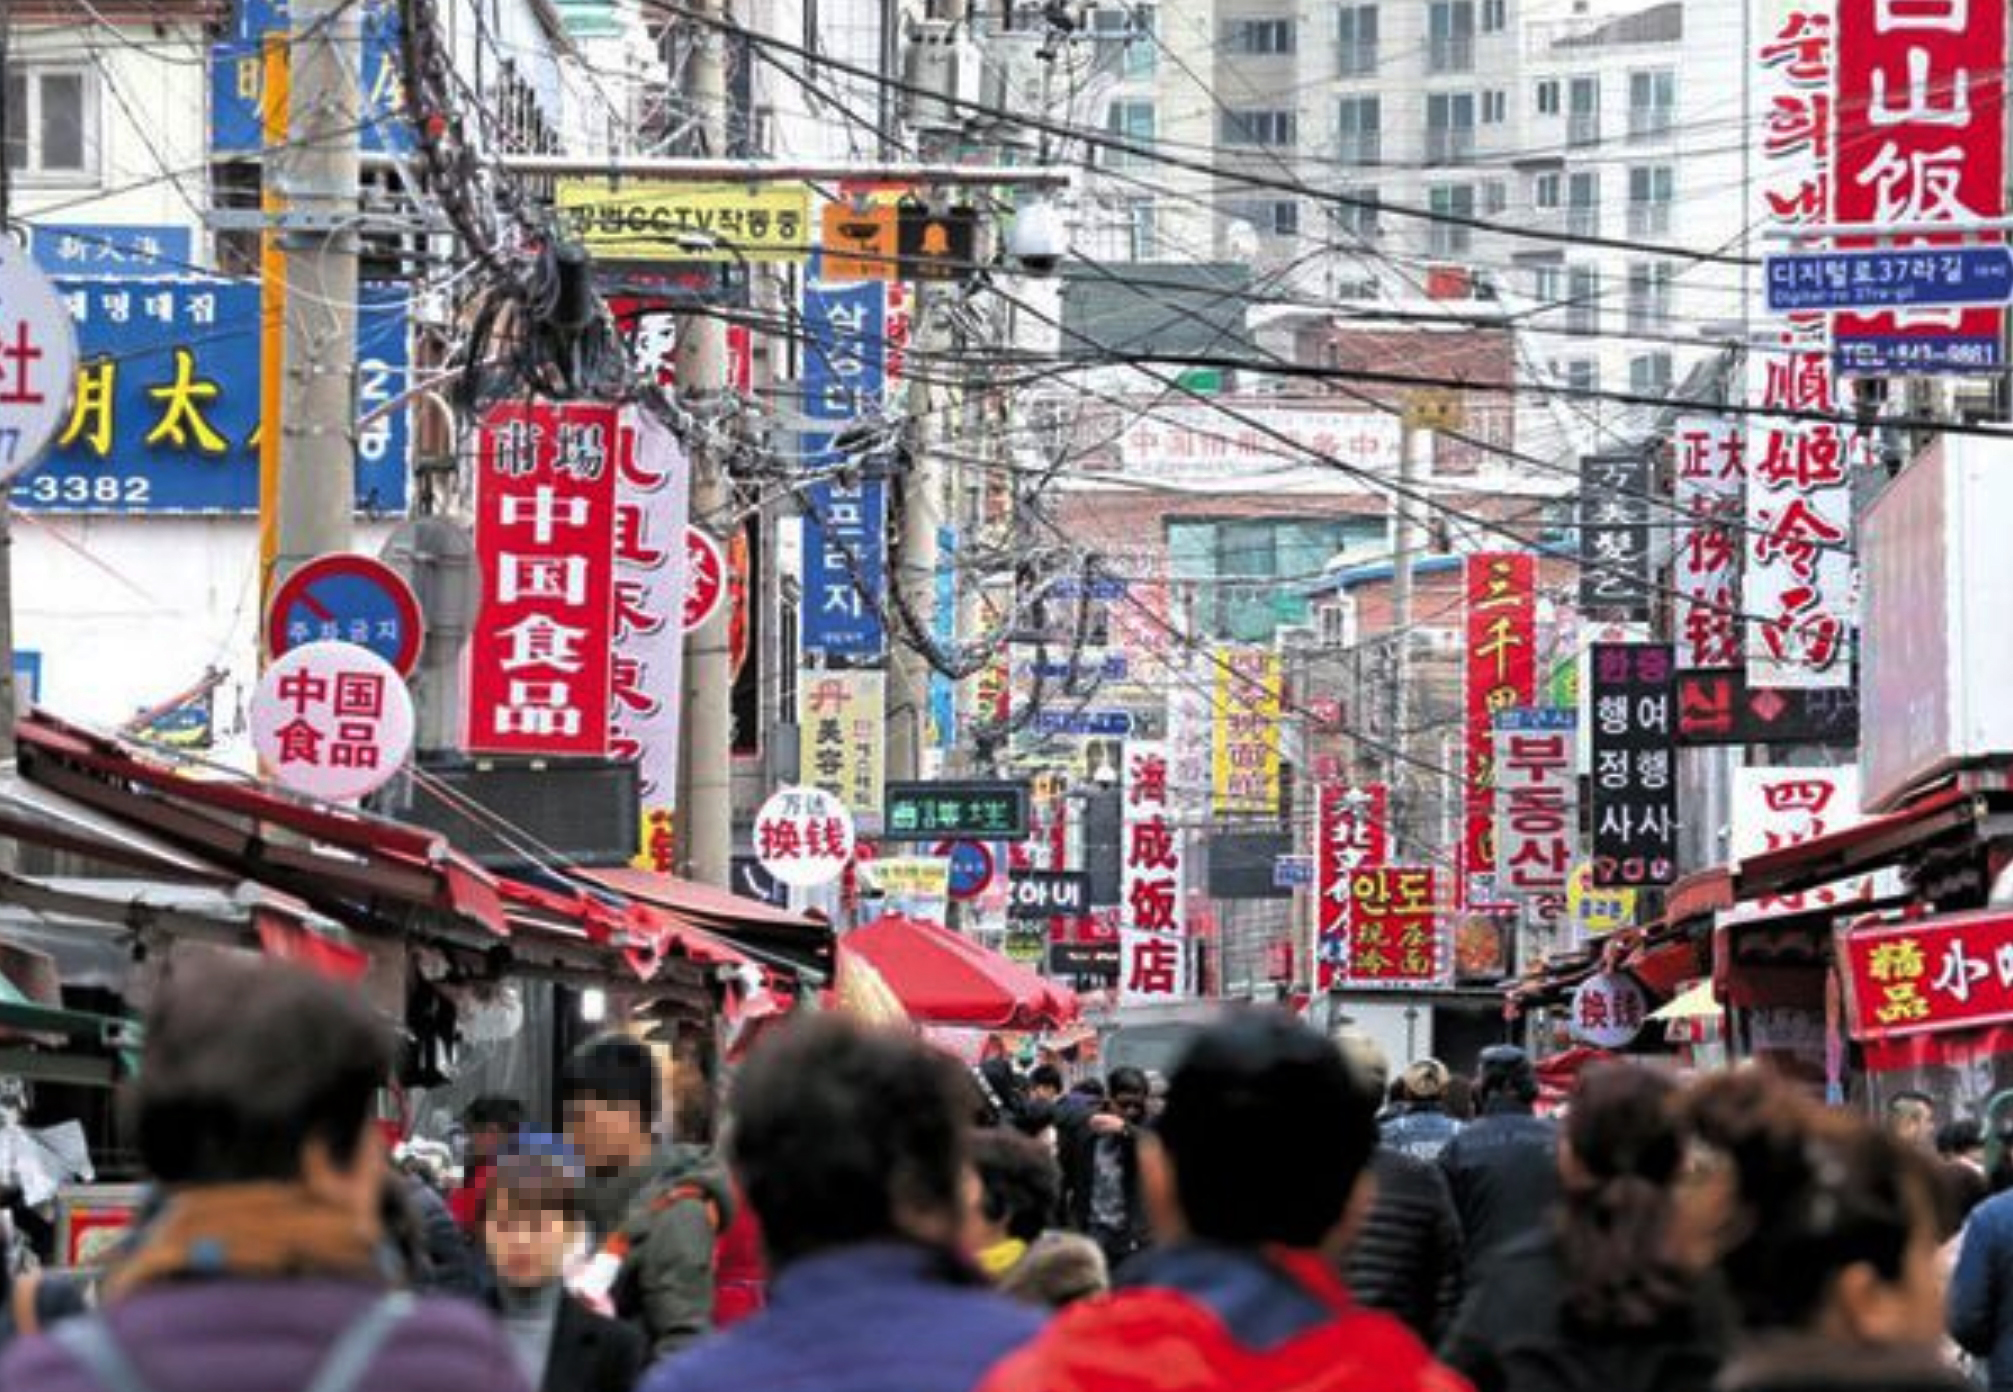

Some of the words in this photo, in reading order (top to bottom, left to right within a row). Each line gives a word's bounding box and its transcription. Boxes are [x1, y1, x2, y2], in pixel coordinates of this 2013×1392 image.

[494, 484, 590, 736] 中国食品
[277, 667, 385, 720] 中国
[273, 717, 380, 768] 食品
[760, 816, 846, 860] 换钱
[1506, 735, 1572, 888] 부동산
